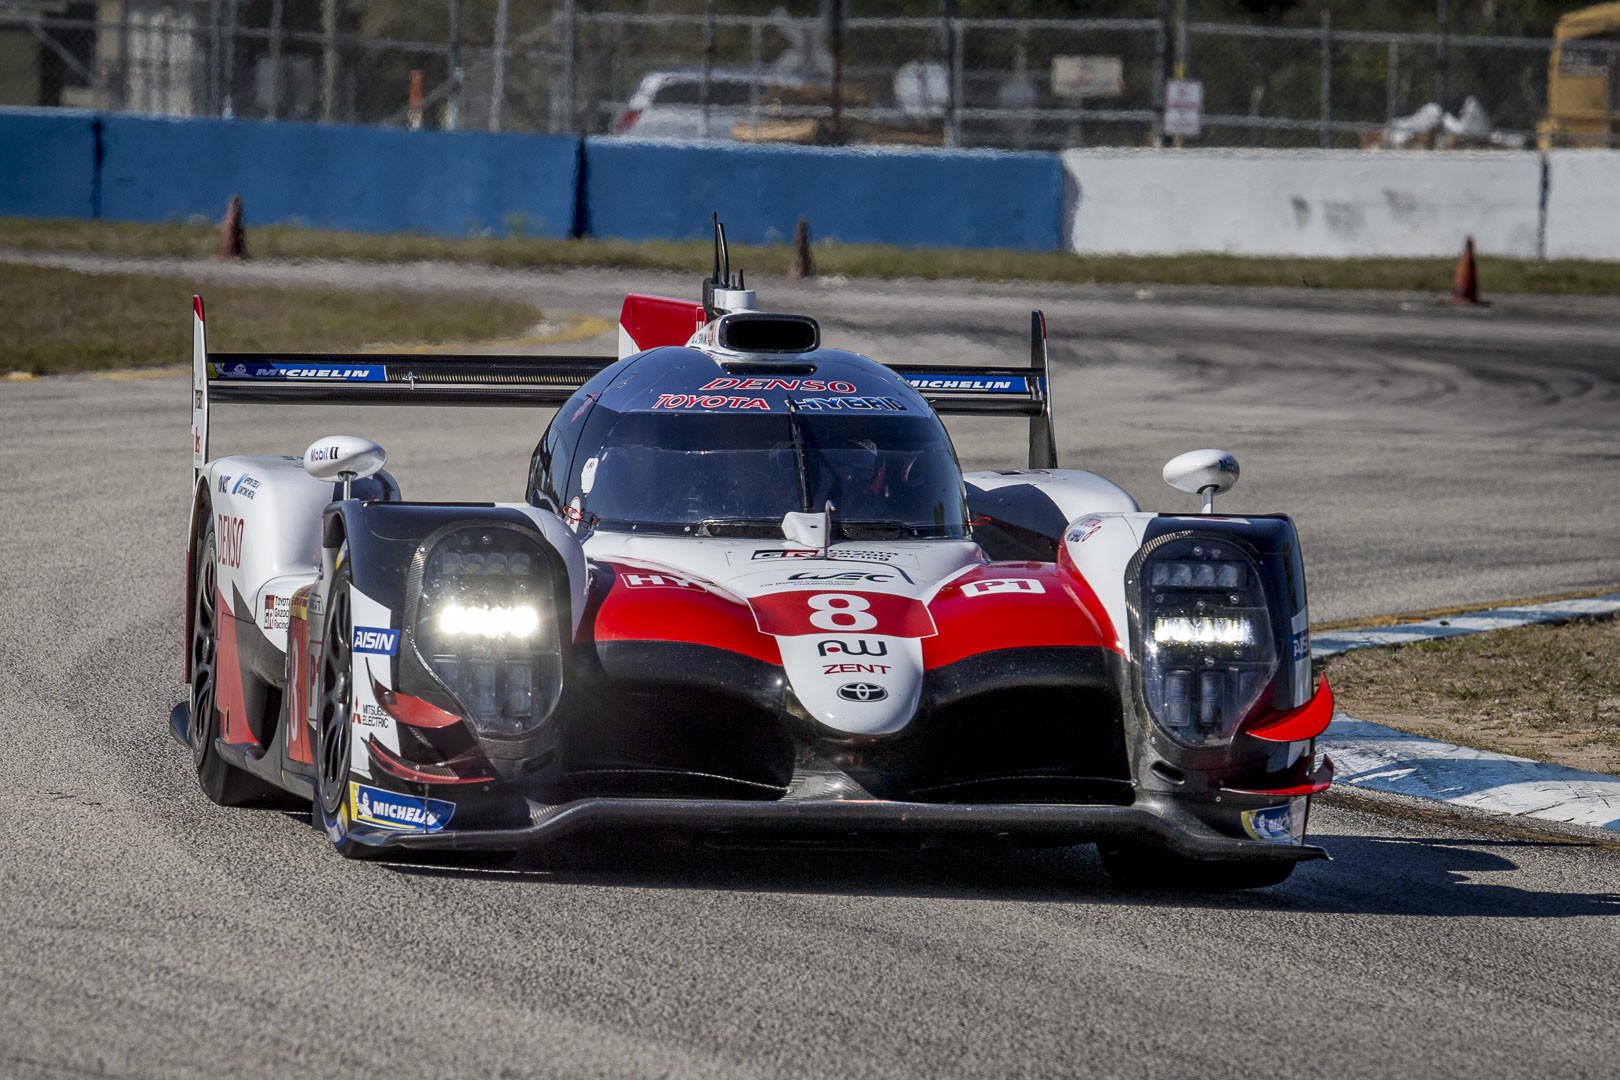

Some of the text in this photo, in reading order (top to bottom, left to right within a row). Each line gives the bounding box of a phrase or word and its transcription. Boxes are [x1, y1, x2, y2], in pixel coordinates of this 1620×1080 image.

[256, 369, 370, 378] MICHELIN
[698, 377, 857, 393] DENSO
[651, 393, 771, 411] TOYOTA
[784, 396, 908, 412] HYBRID
[310, 447, 329, 462] Mobil
[217, 513, 244, 569] DENSO
[752, 550, 819, 560] GR
[787, 572, 895, 583] WEC
[974, 580, 1032, 592] P1
[807, 593, 878, 631] 8
[354, 630, 395, 651] AISIN
[822, 663, 892, 675] ZENT
[363, 714, 389, 729] ELECTRIC
